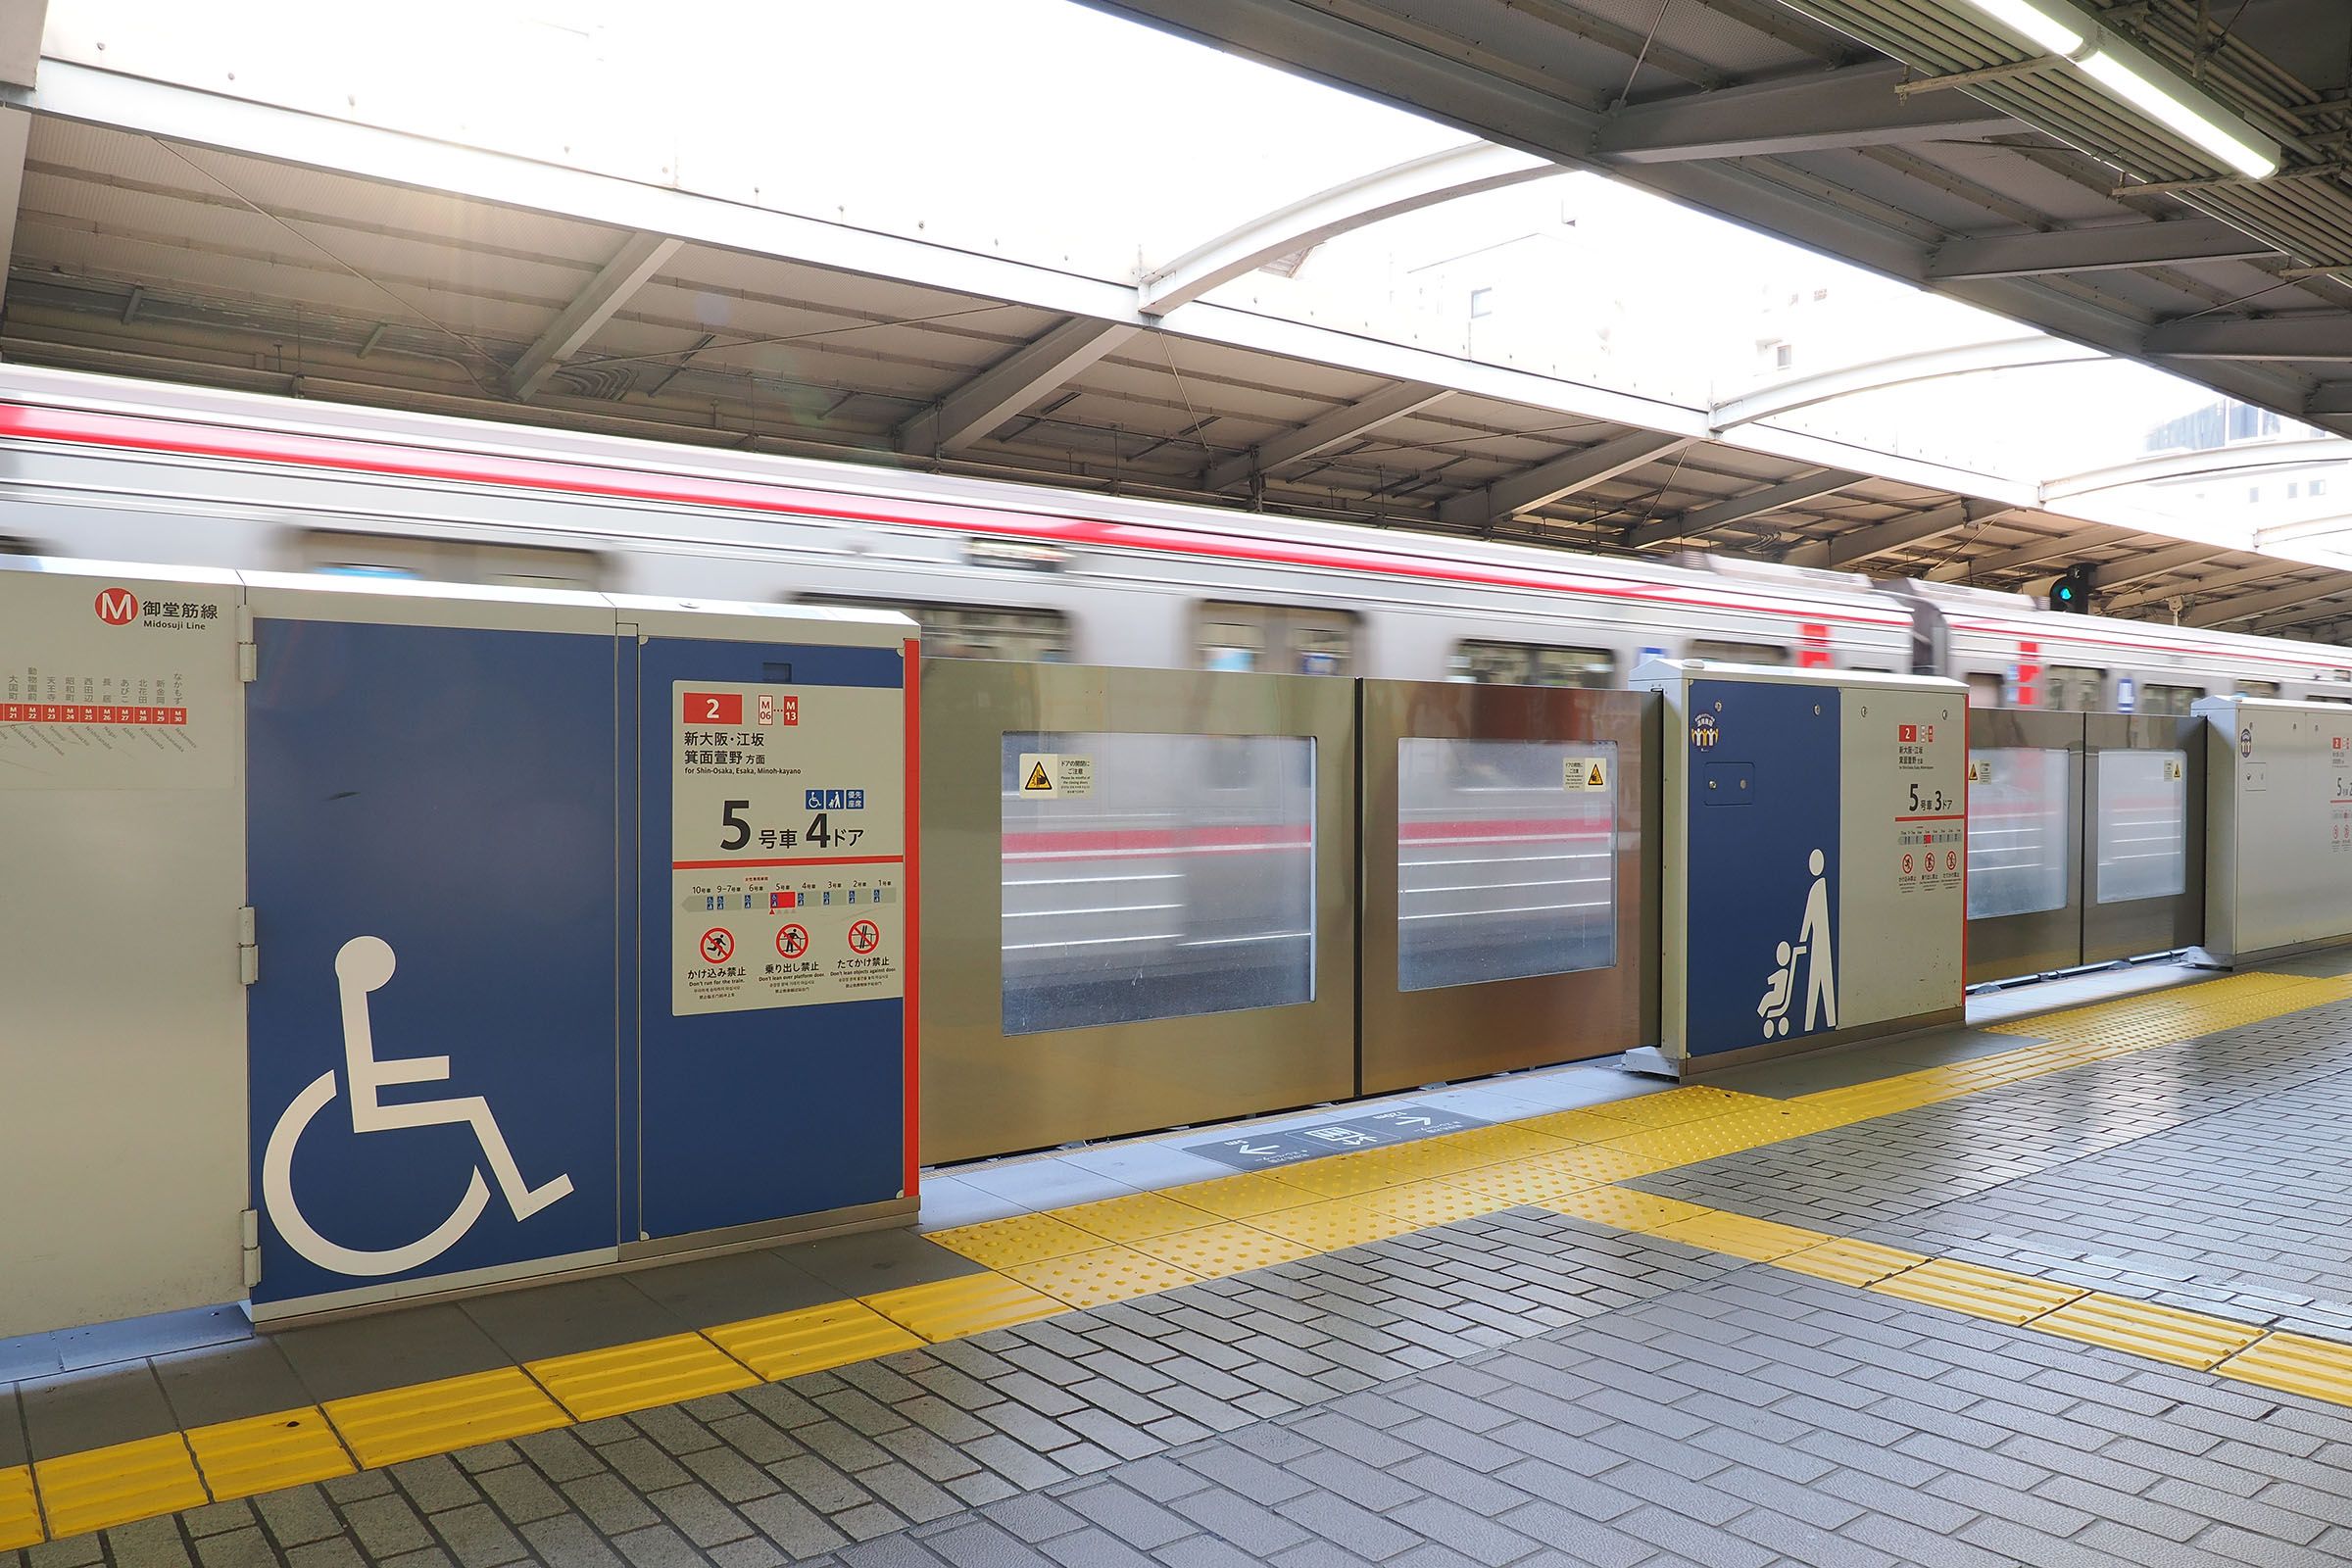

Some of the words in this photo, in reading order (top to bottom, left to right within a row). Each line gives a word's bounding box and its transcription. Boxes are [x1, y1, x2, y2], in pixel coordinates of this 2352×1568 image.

[101, 592, 132, 620] M
[142, 600, 219, 619] 御堂筋線
[143, 619, 183, 630] Midosuji
[186, 621, 206, 630] Line
[9, 675, 19, 701] 大国町
[47, 676, 56, 702] 天王寺
[65, 676, 74, 703] 昭和町
[84, 677, 93, 703] 西田辺
[121, 678, 129, 704] あびこ
[138, 678, 148, 704] 北花田
[172, 672, 183, 705] なかもず
[706, 698, 720, 719] 2
[760, 701, 770, 710] M
[786, 701, 796, 710] M
[760, 710, 771, 720] 06
[785, 711, 797, 721] 13
[684, 731, 764, 747] 新大阪・江坂
[1905, 727, 1910, 739] 2
[746, 754, 765, 764] 方面
[758, 767, 802, 776] Minoh-kayano
[765, 961, 819, 974] 乗り出し禁止
[837, 956, 890, 969] たてかけ禁止
[687, 966, 747, 979] かけ込み禁止
